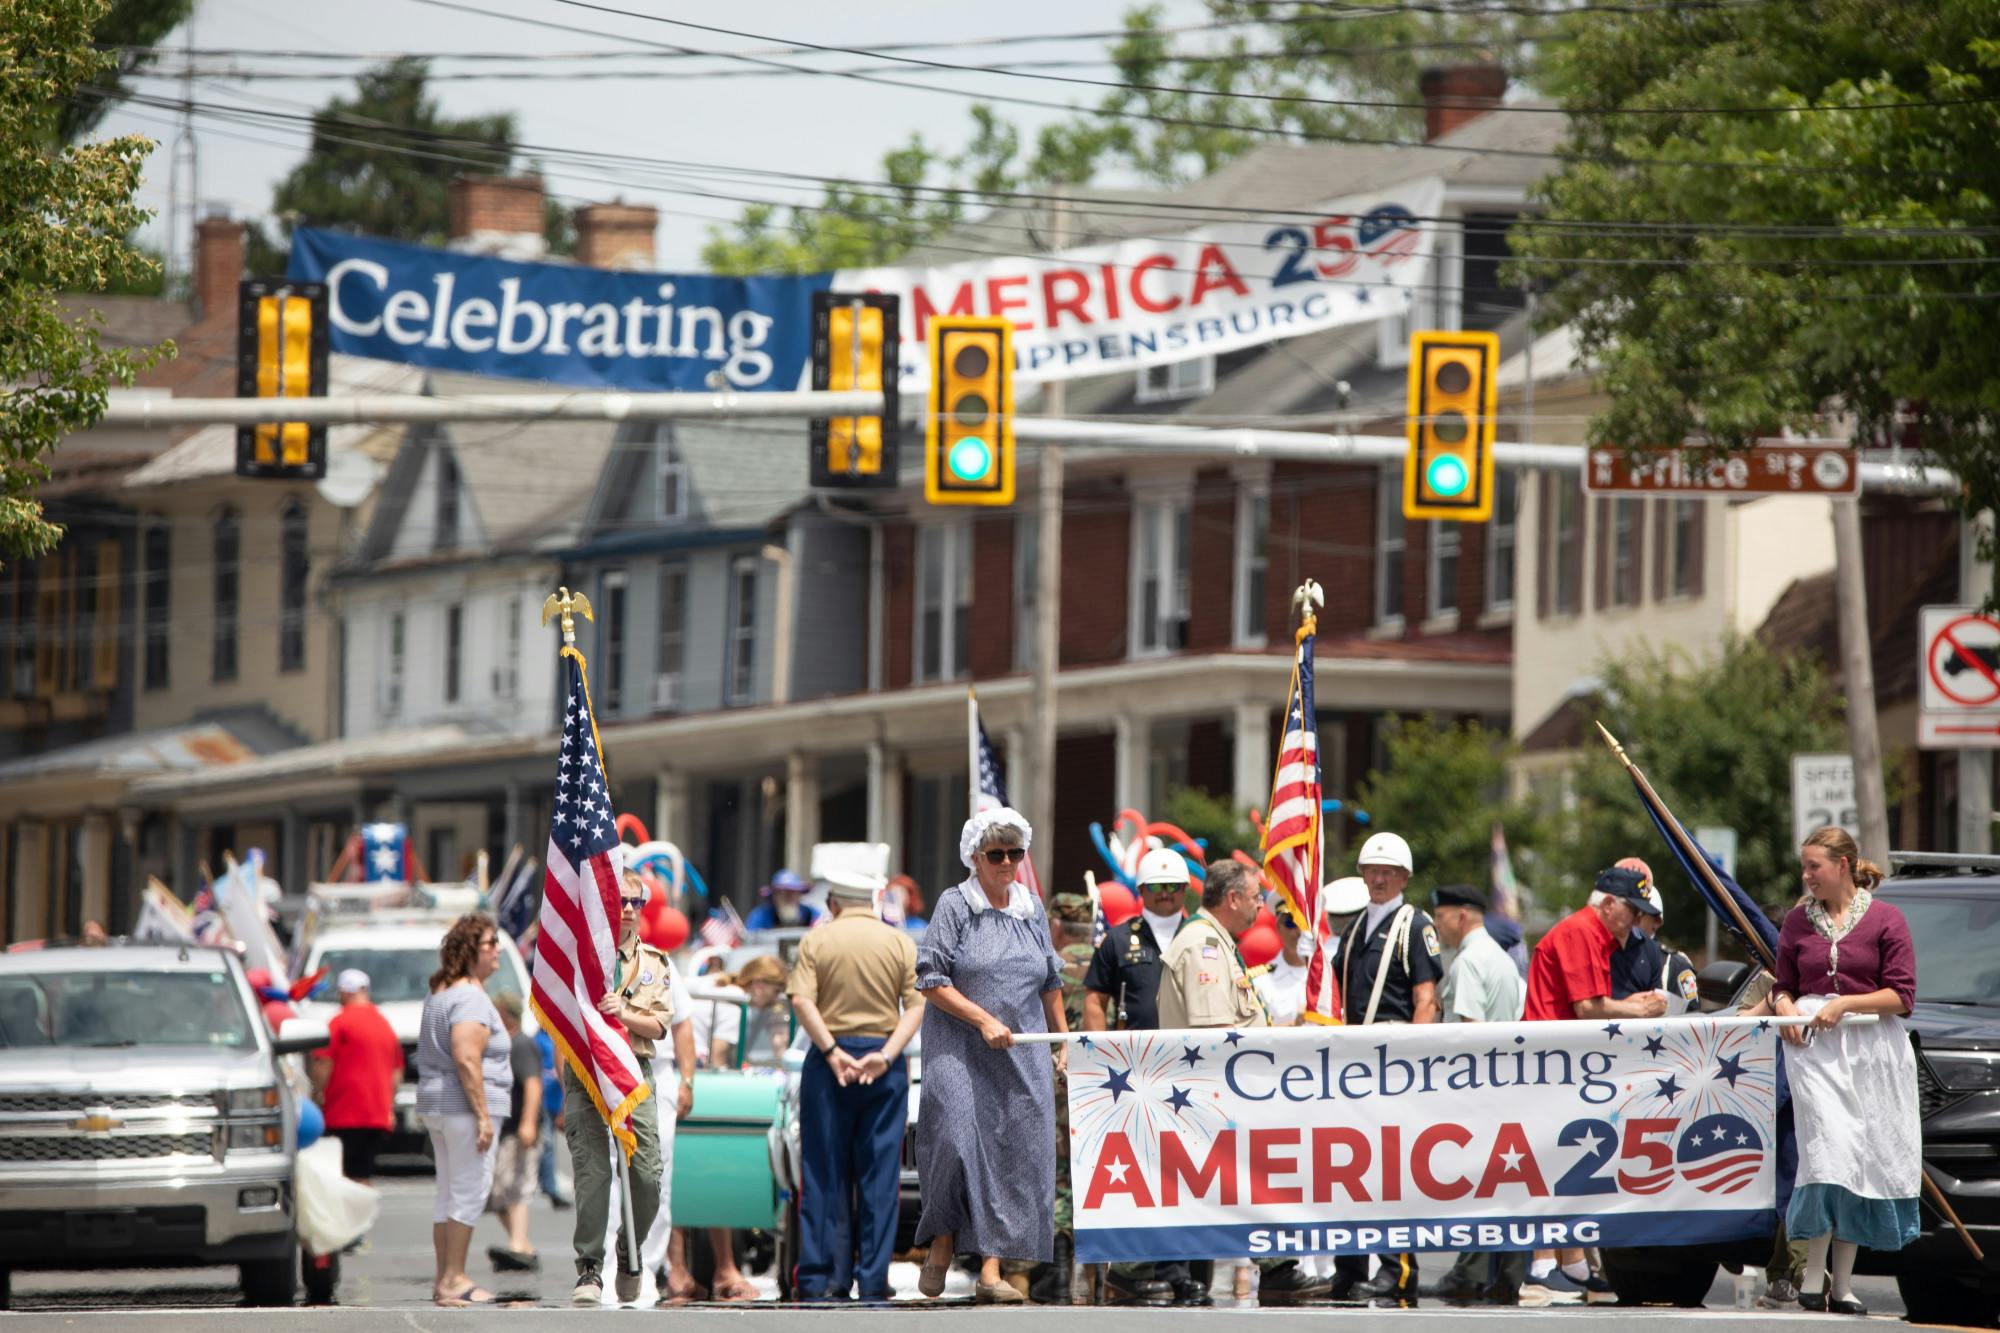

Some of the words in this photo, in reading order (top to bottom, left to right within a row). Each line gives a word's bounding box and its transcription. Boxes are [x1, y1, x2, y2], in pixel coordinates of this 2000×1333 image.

[327, 257, 773, 387] Celebrating
[864, 242, 1251, 343] MERICA
[1012, 292, 1332, 371] IPPENSBURG
[1224, 1035, 1618, 1105] Celebrating
[1248, 1221, 1601, 1253] SHIPPENSBURG
